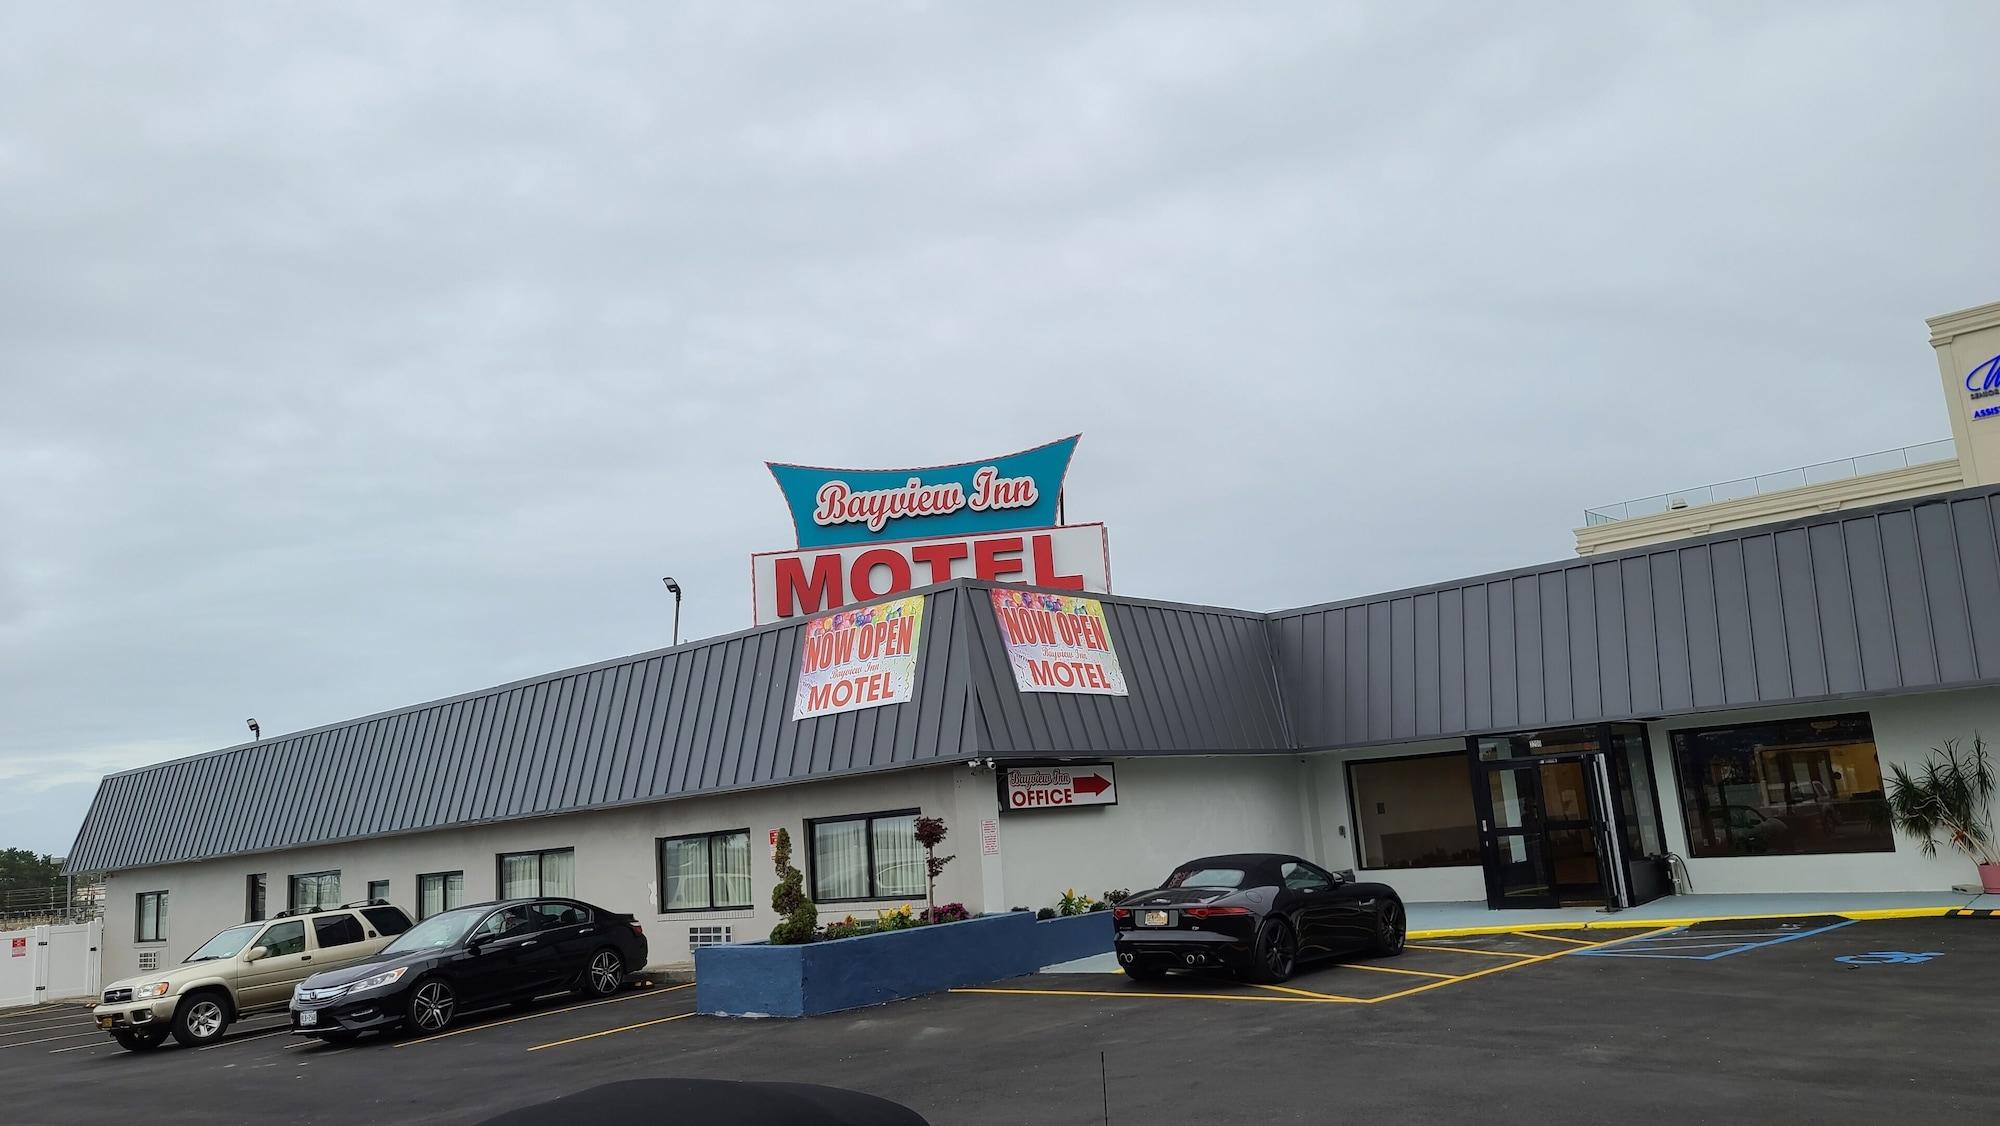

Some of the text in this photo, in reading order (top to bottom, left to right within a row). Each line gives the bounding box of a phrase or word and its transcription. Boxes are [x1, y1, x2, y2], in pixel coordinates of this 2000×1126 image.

[1974, 405, 2000, 419] ASSIS
[815, 467, 1038, 532] Bayview Inn
[775, 534, 1084, 618] MOTEL
[804, 615, 915, 674] NOW OPEN
[1002, 607, 1109, 652] NOW OPEN
[807, 672, 894, 711] MOTEL
[1027, 659, 1112, 689] MOTEL
[1011, 768, 1071, 790] Bayview Inn
[1012, 789, 1073, 807] OFFICE
